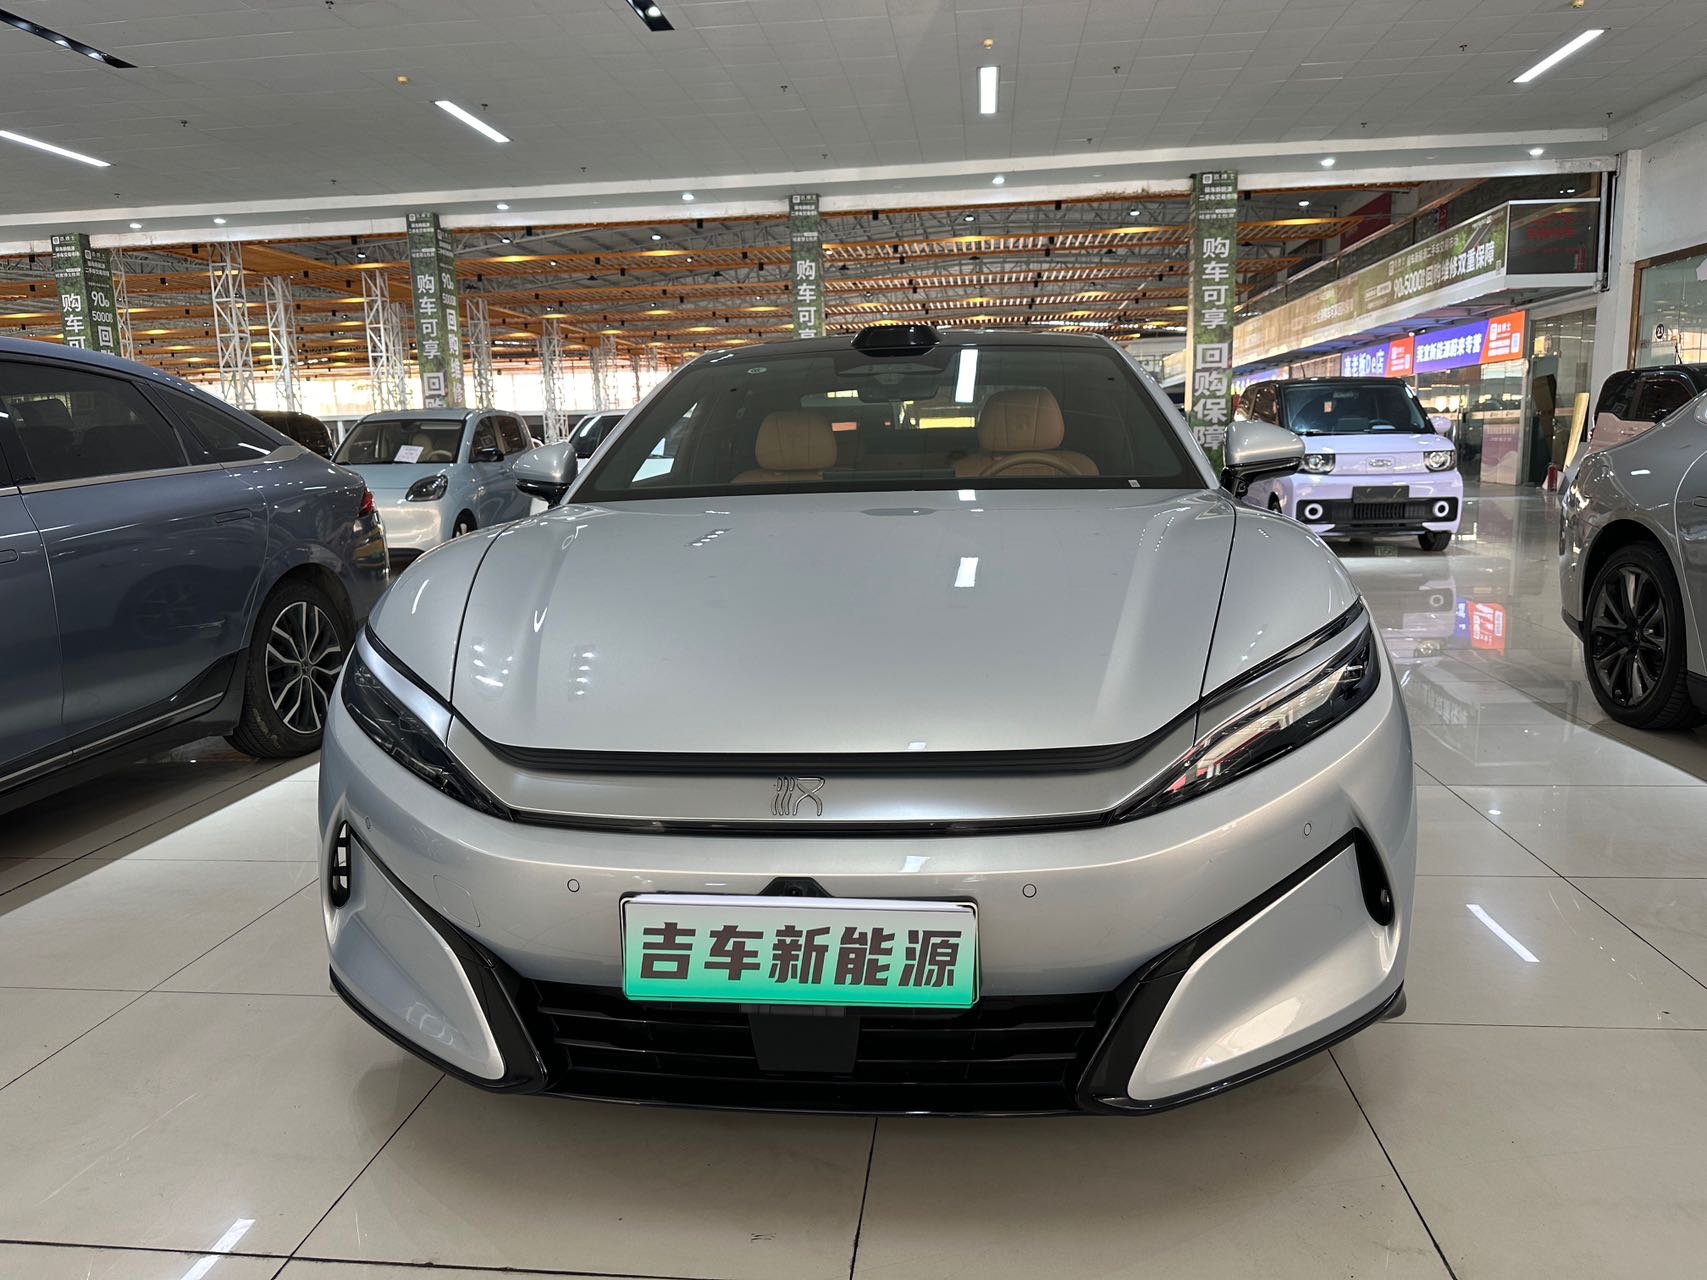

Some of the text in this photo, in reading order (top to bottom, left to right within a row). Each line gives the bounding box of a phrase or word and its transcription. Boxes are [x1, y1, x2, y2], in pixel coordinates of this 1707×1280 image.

[417, 273, 440, 360] 购车可享
[1201, 236, 1231, 329] 购车可享
[1193, 342, 1229, 450] 回购保障
[640, 921, 962, 988] 吉车新能源
